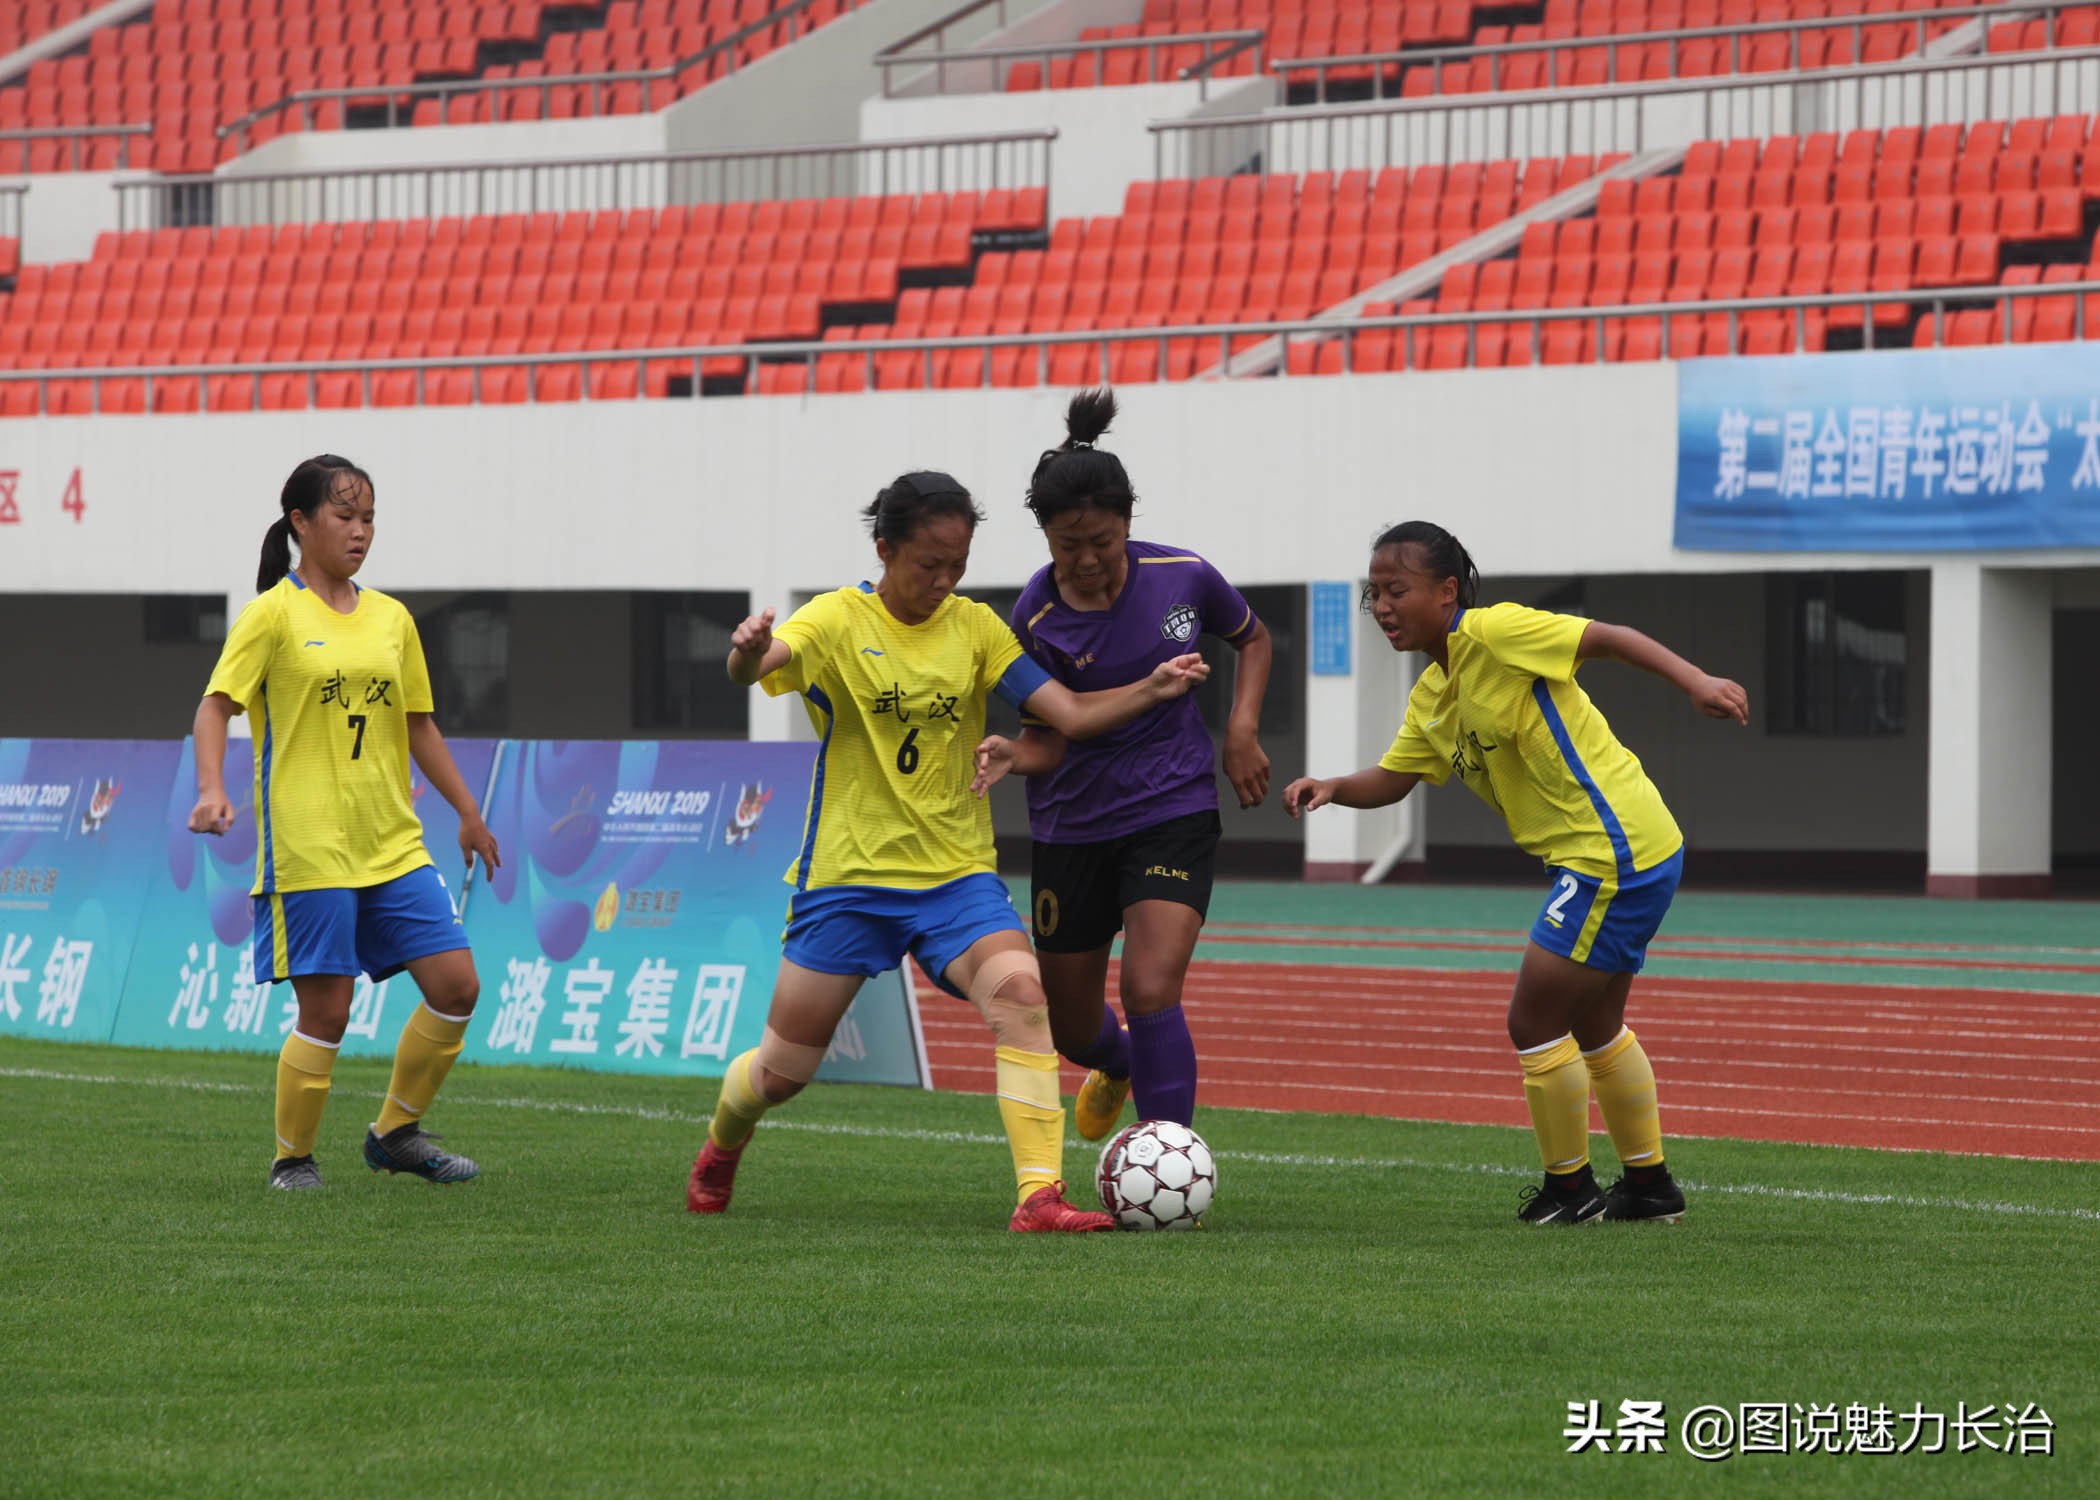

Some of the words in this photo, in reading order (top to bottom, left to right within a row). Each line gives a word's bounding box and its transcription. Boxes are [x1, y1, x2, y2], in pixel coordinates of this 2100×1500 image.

[61, 466, 86, 523] 4
[320, 669, 392, 708] 武汉
[872, 682, 960, 722] 武汉
[347, 714, 366, 760] 7
[896, 728, 920, 774] 6
[607, 791, 672, 815] SHANXI
[670, 790, 710, 815] 2019
[1145, 865, 1190, 881] KELME
[1546, 874, 1579, 923] 2
[0, 932, 94, 1028] 长钢
[167, 941, 390, 1040] 沁新团
[487, 956, 747, 1061] 潞宝集团
